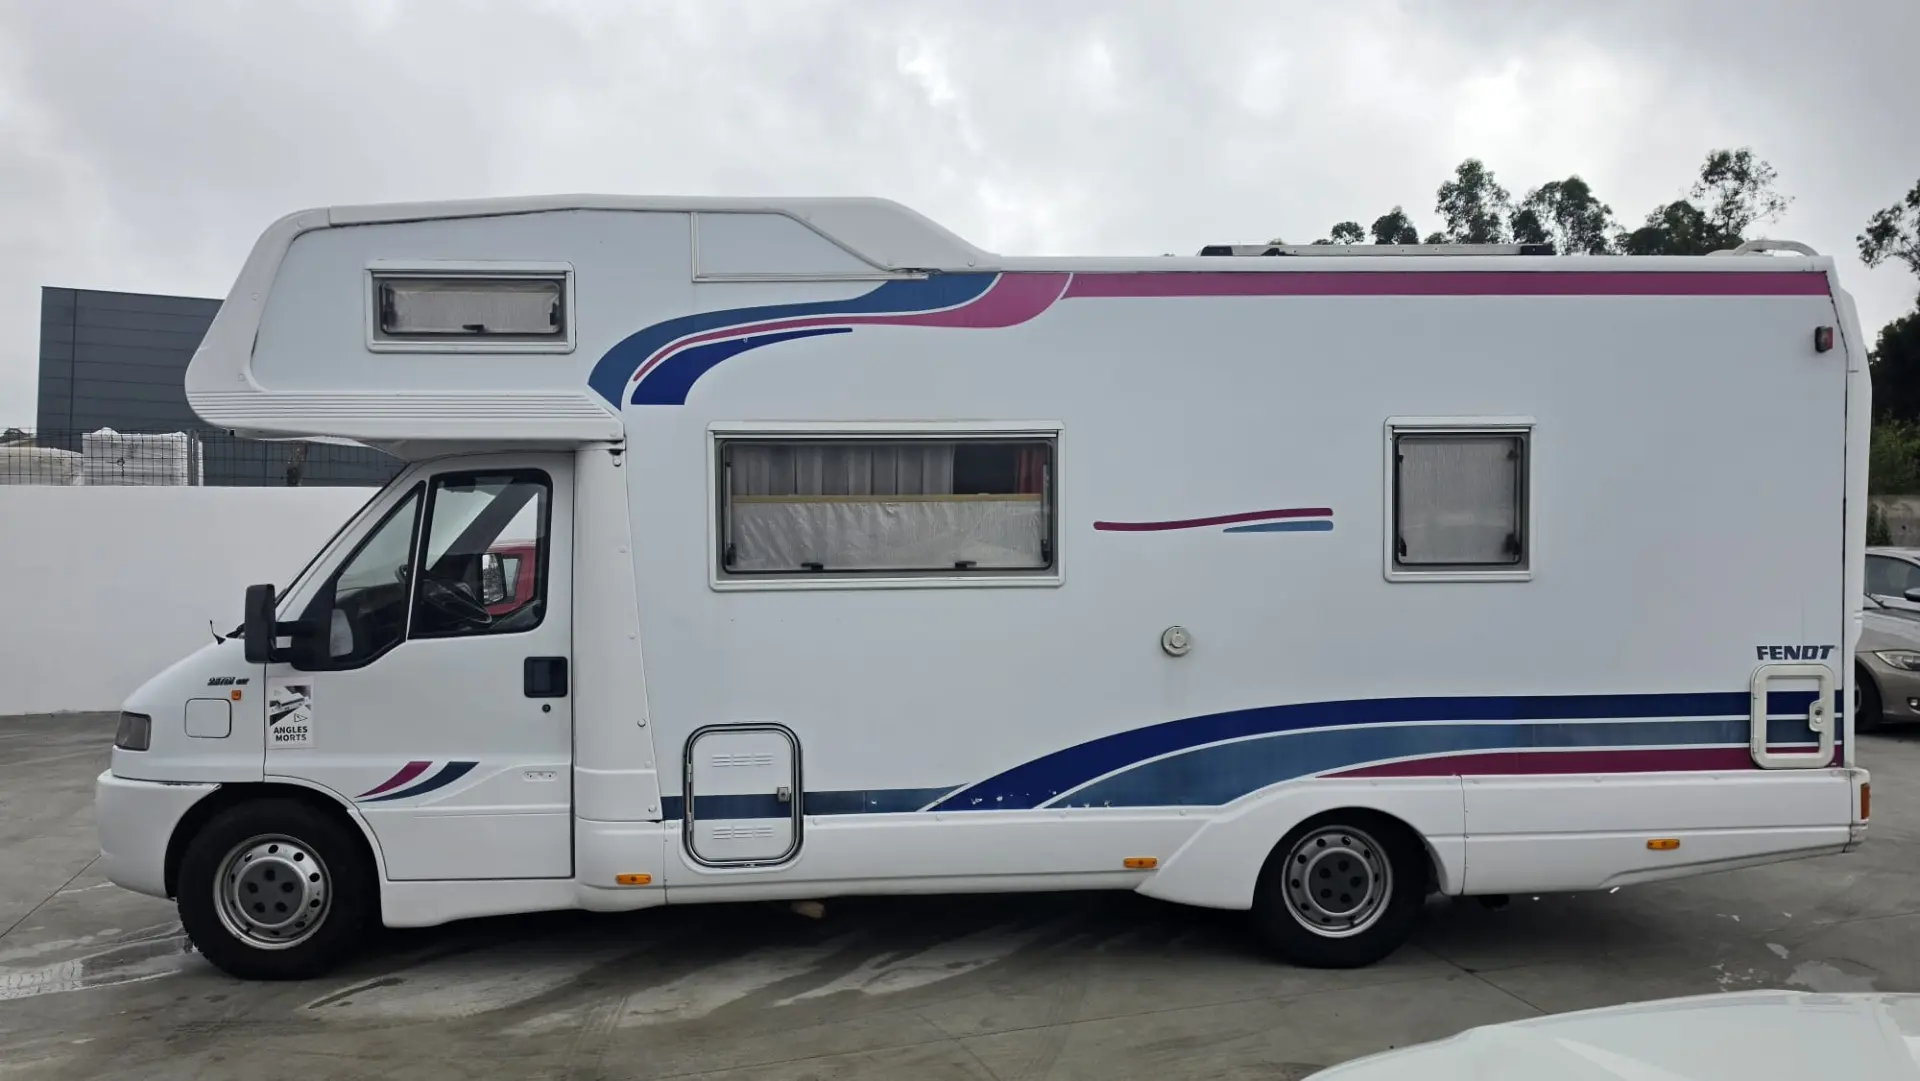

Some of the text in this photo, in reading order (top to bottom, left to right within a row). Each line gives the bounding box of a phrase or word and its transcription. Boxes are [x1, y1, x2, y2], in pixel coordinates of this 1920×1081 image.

[1756, 645, 1835, 660] FENDT
[273, 726, 308, 734] ANGLES
[275, 734, 307, 742] MORTS
